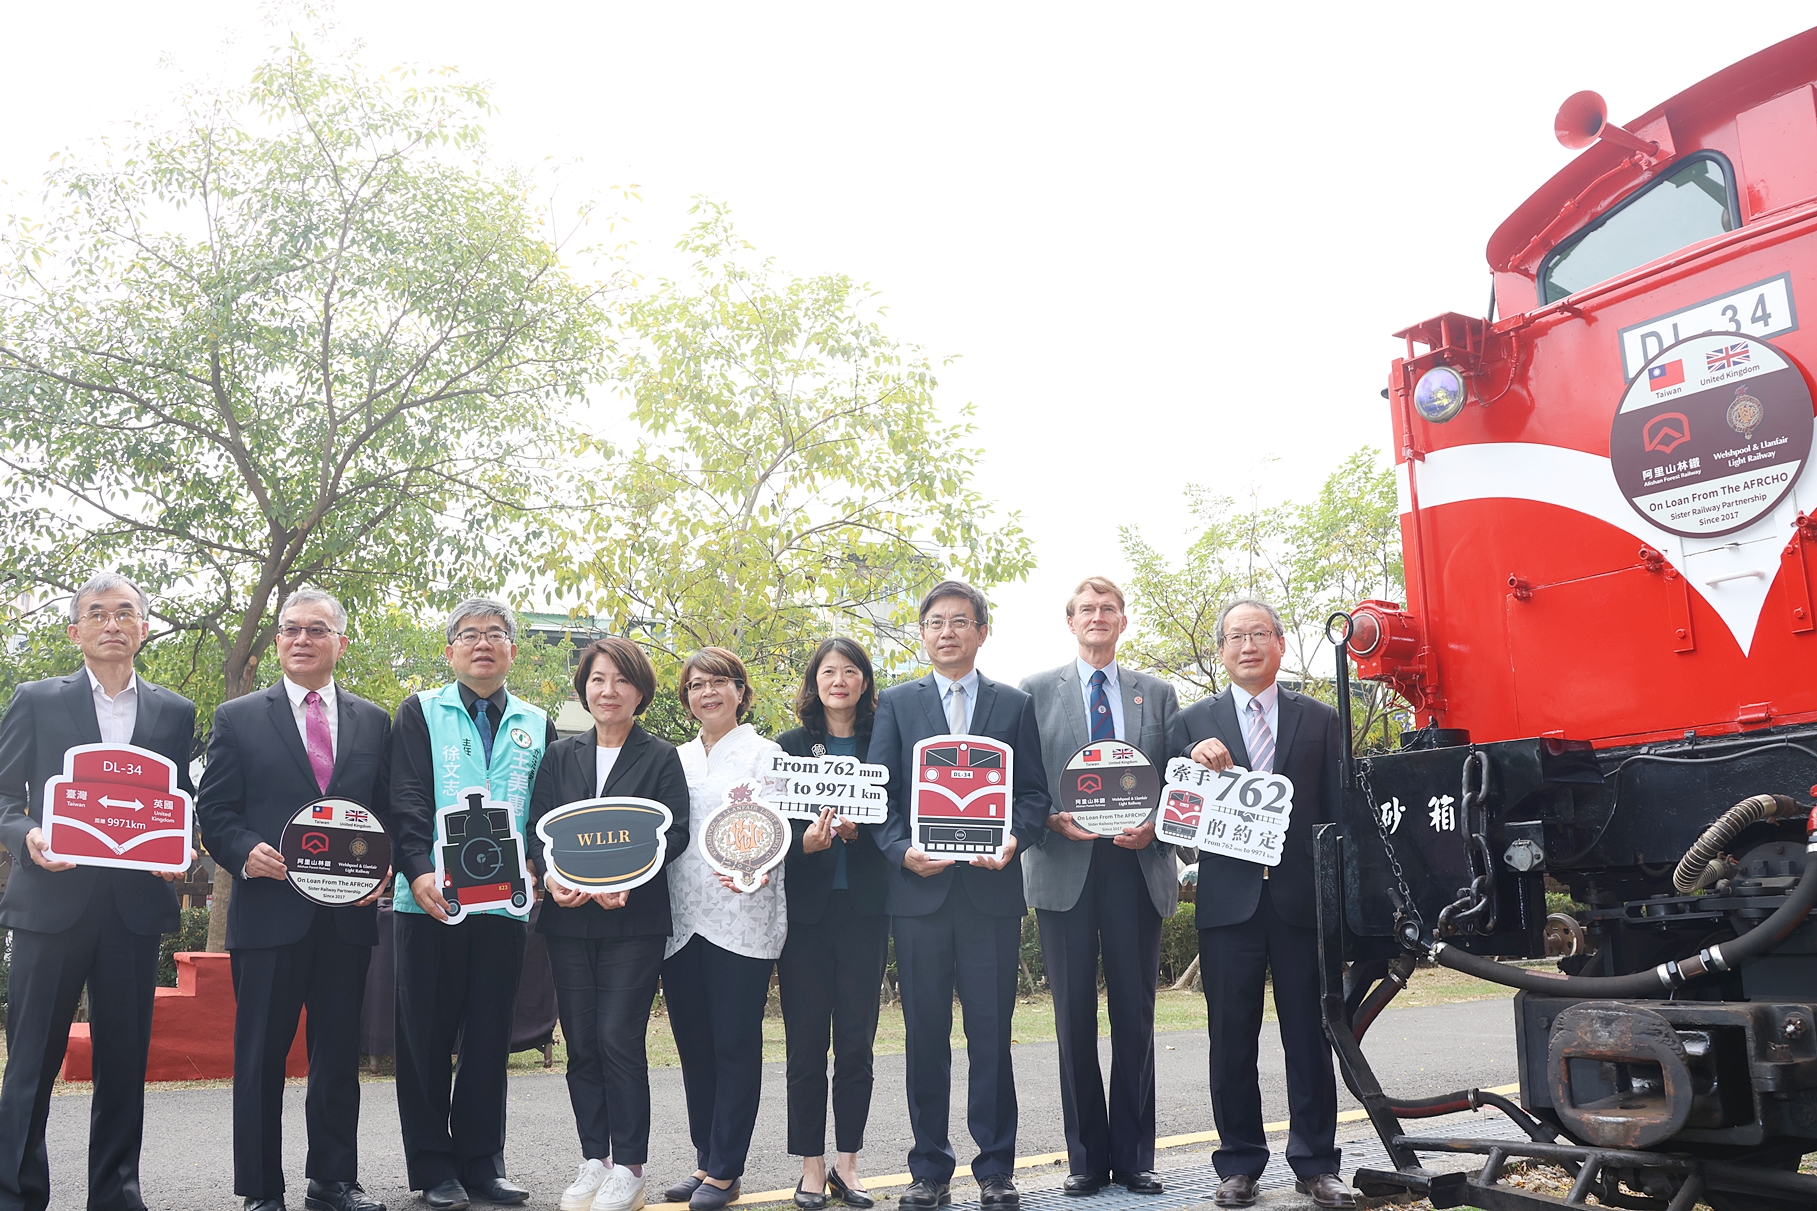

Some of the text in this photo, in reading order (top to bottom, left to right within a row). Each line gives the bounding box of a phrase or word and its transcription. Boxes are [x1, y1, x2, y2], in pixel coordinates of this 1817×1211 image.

[1700, 364, 1760, 386] United Kingdom
[1655, 386, 1682, 399] Taiwan
[1713, 436, 1789, 460] Welshpool & Llanfair
[1727, 451, 1776, 468] Light Railway
[1644, 469, 1701, 487] Alishan Forest Railway
[1649, 472, 1789, 512] On Loan From The AFRCHO
[1670, 492, 1767, 520] Sister Railway Partnership
[1699, 511, 1739, 526] Since 2017
[462, 737, 472, 756] 主任
[103, 760, 143, 776] DL-34
[443, 745, 461, 797] 徐文志
[771, 757, 883, 778] From 762 mm
[507, 748, 530, 817] 王美惠
[794, 782, 881, 800] to 9971 km
[1172, 763, 1210, 786] 牽手
[1215, 770, 1287, 814] 762
[65, 789, 88, 801] 臺灣
[153, 799, 174, 811] 英國
[1380, 794, 1456, 835] 砂箱
[107, 817, 146, 830] 9971km
[151, 816, 175, 824] Kingdom
[577, 829, 631, 847] WLLR
[1206, 818, 1278, 850] 的約定
[1204, 838, 1221, 847] From
[1222, 842, 1233, 850] 762
[1251, 849, 1266, 857] 9971
